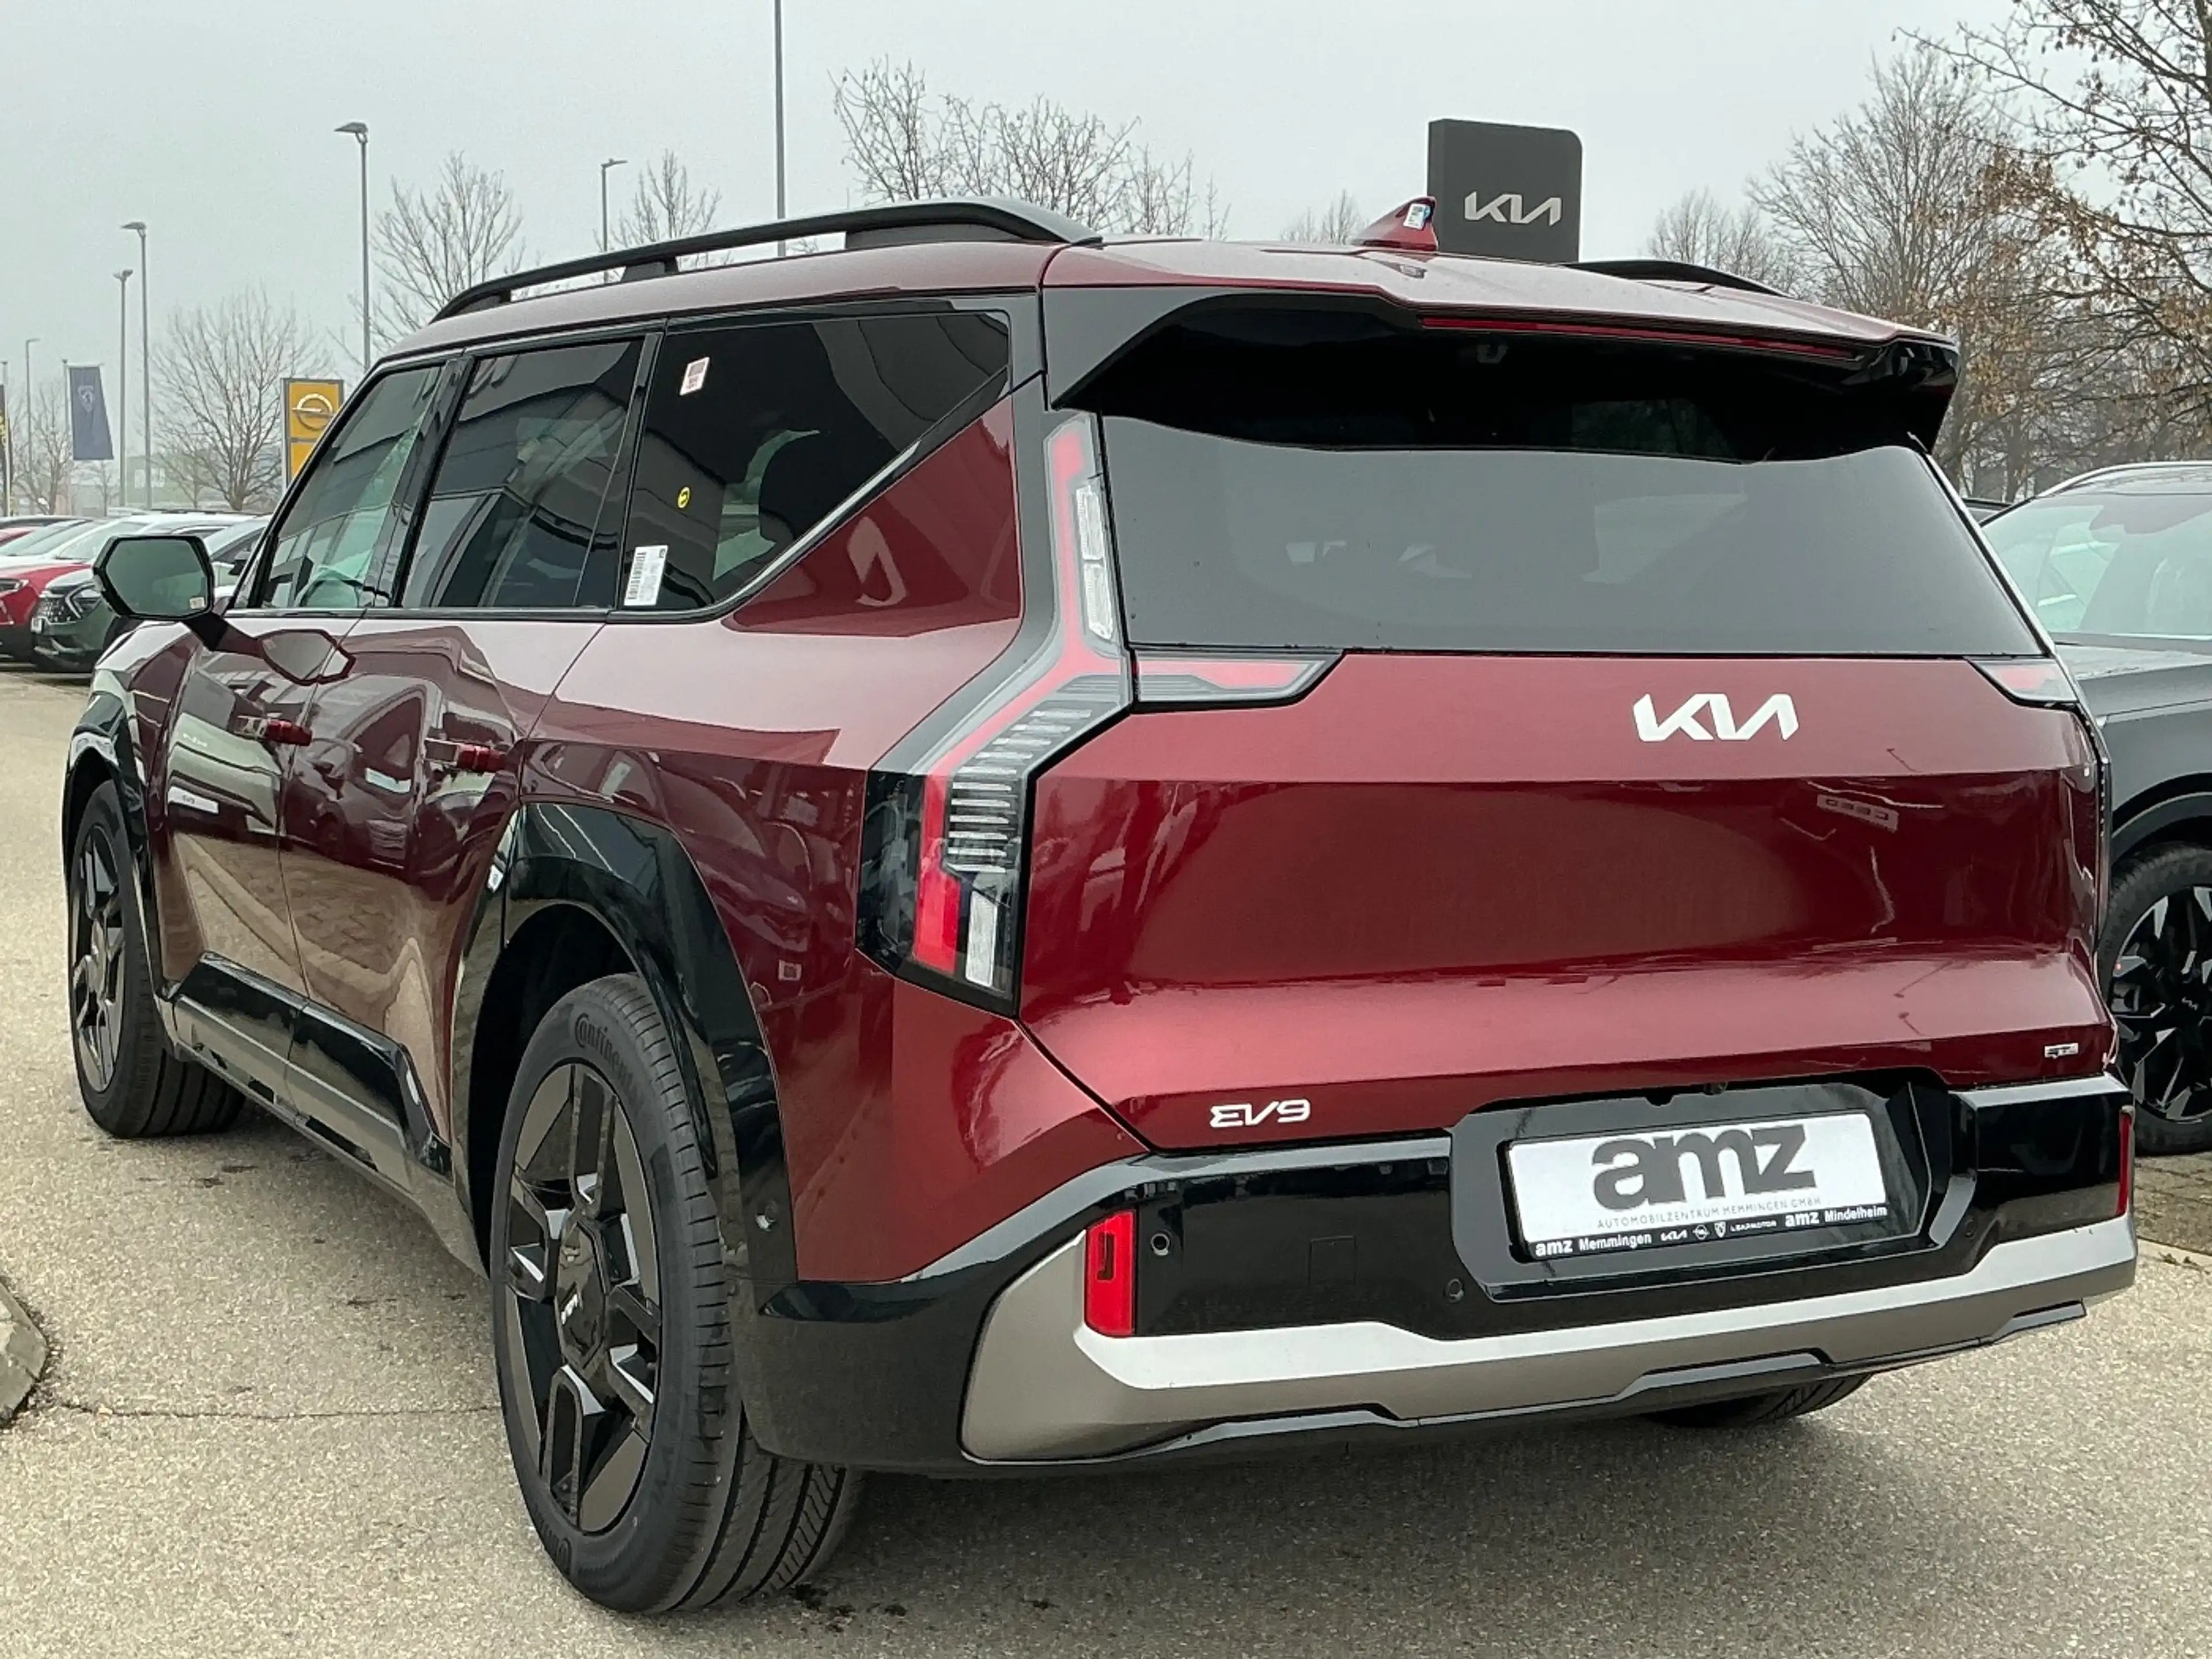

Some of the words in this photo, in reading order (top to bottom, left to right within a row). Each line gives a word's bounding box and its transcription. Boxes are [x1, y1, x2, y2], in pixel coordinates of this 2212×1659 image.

[1464, 191, 1562, 228] KIA
[1633, 693, 1799, 742] KIA
[1210, 1099, 1310, 1127] EV9
[1591, 1124, 1816, 1211] amz
[1535, 1240, 1573, 1257] amz
[1578, 1233, 1652, 1251] Memmingen
[1785, 1212, 1819, 1227] amz
[1824, 1205, 1888, 1222] Mindelheim
[1597, 1208, 1719, 1229] AUTOMOBILZENTRUM
[1722, 1200, 1787, 1215] MEMMINGEN
